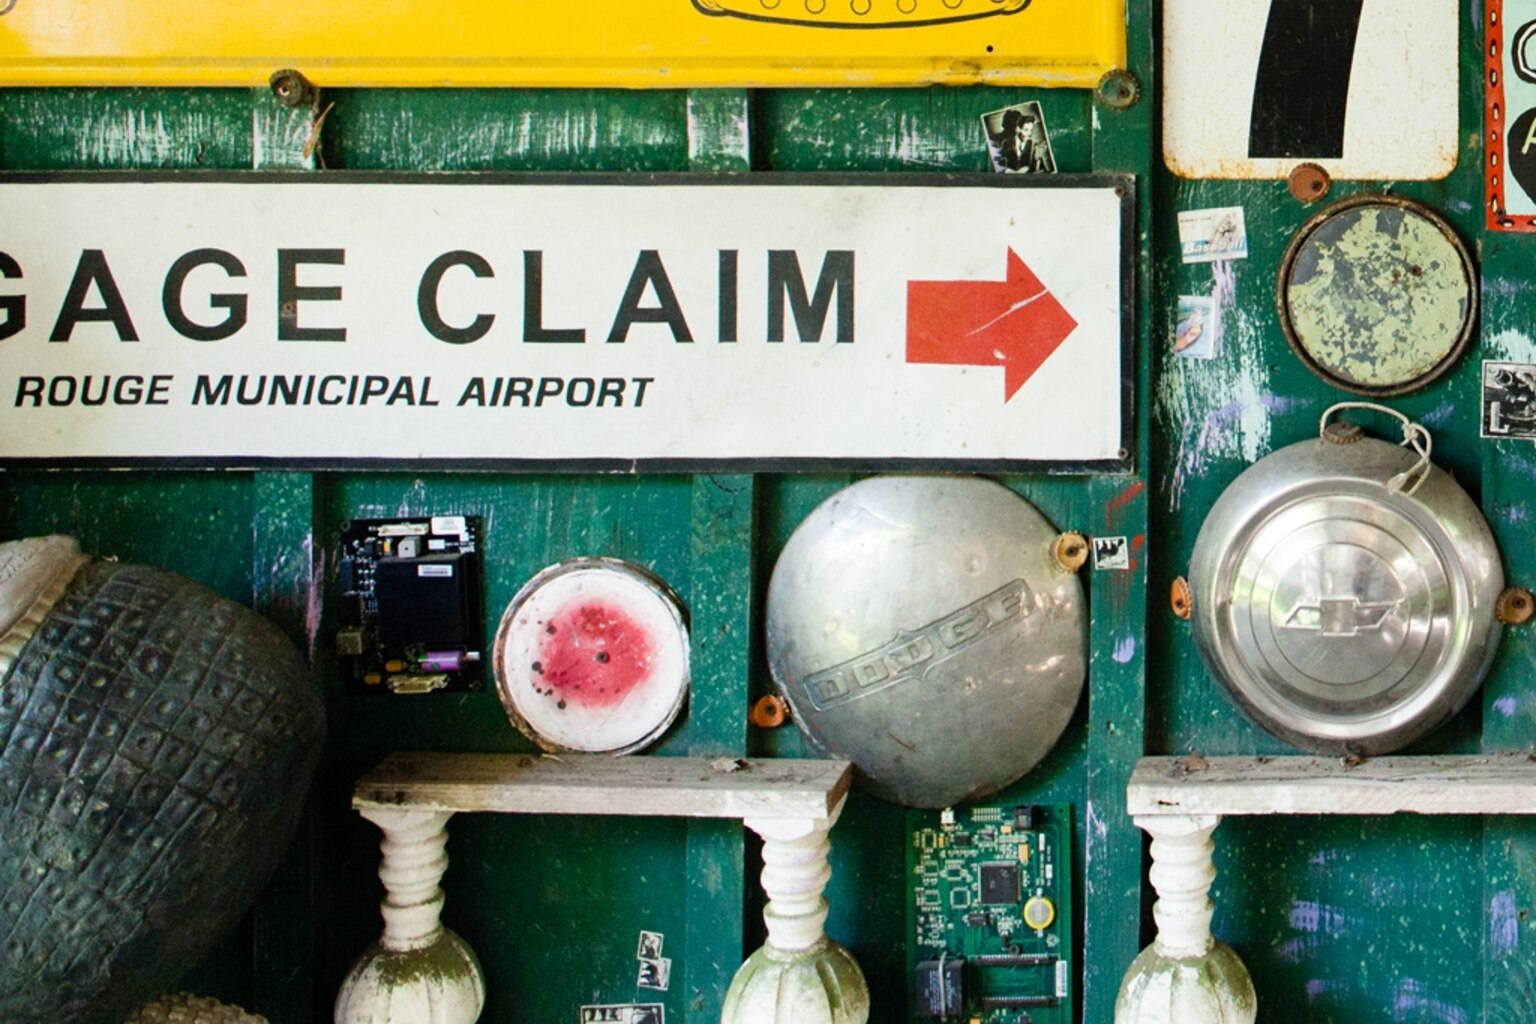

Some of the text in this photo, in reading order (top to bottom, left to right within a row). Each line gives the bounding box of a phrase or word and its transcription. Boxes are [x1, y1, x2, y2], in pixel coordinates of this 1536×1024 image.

[417, 249, 856, 345] CLAIM
[14, 375, 655, 408] ROUGE MUNICIPAL AIRPORT
[812, 587, 1028, 704] DODGE
